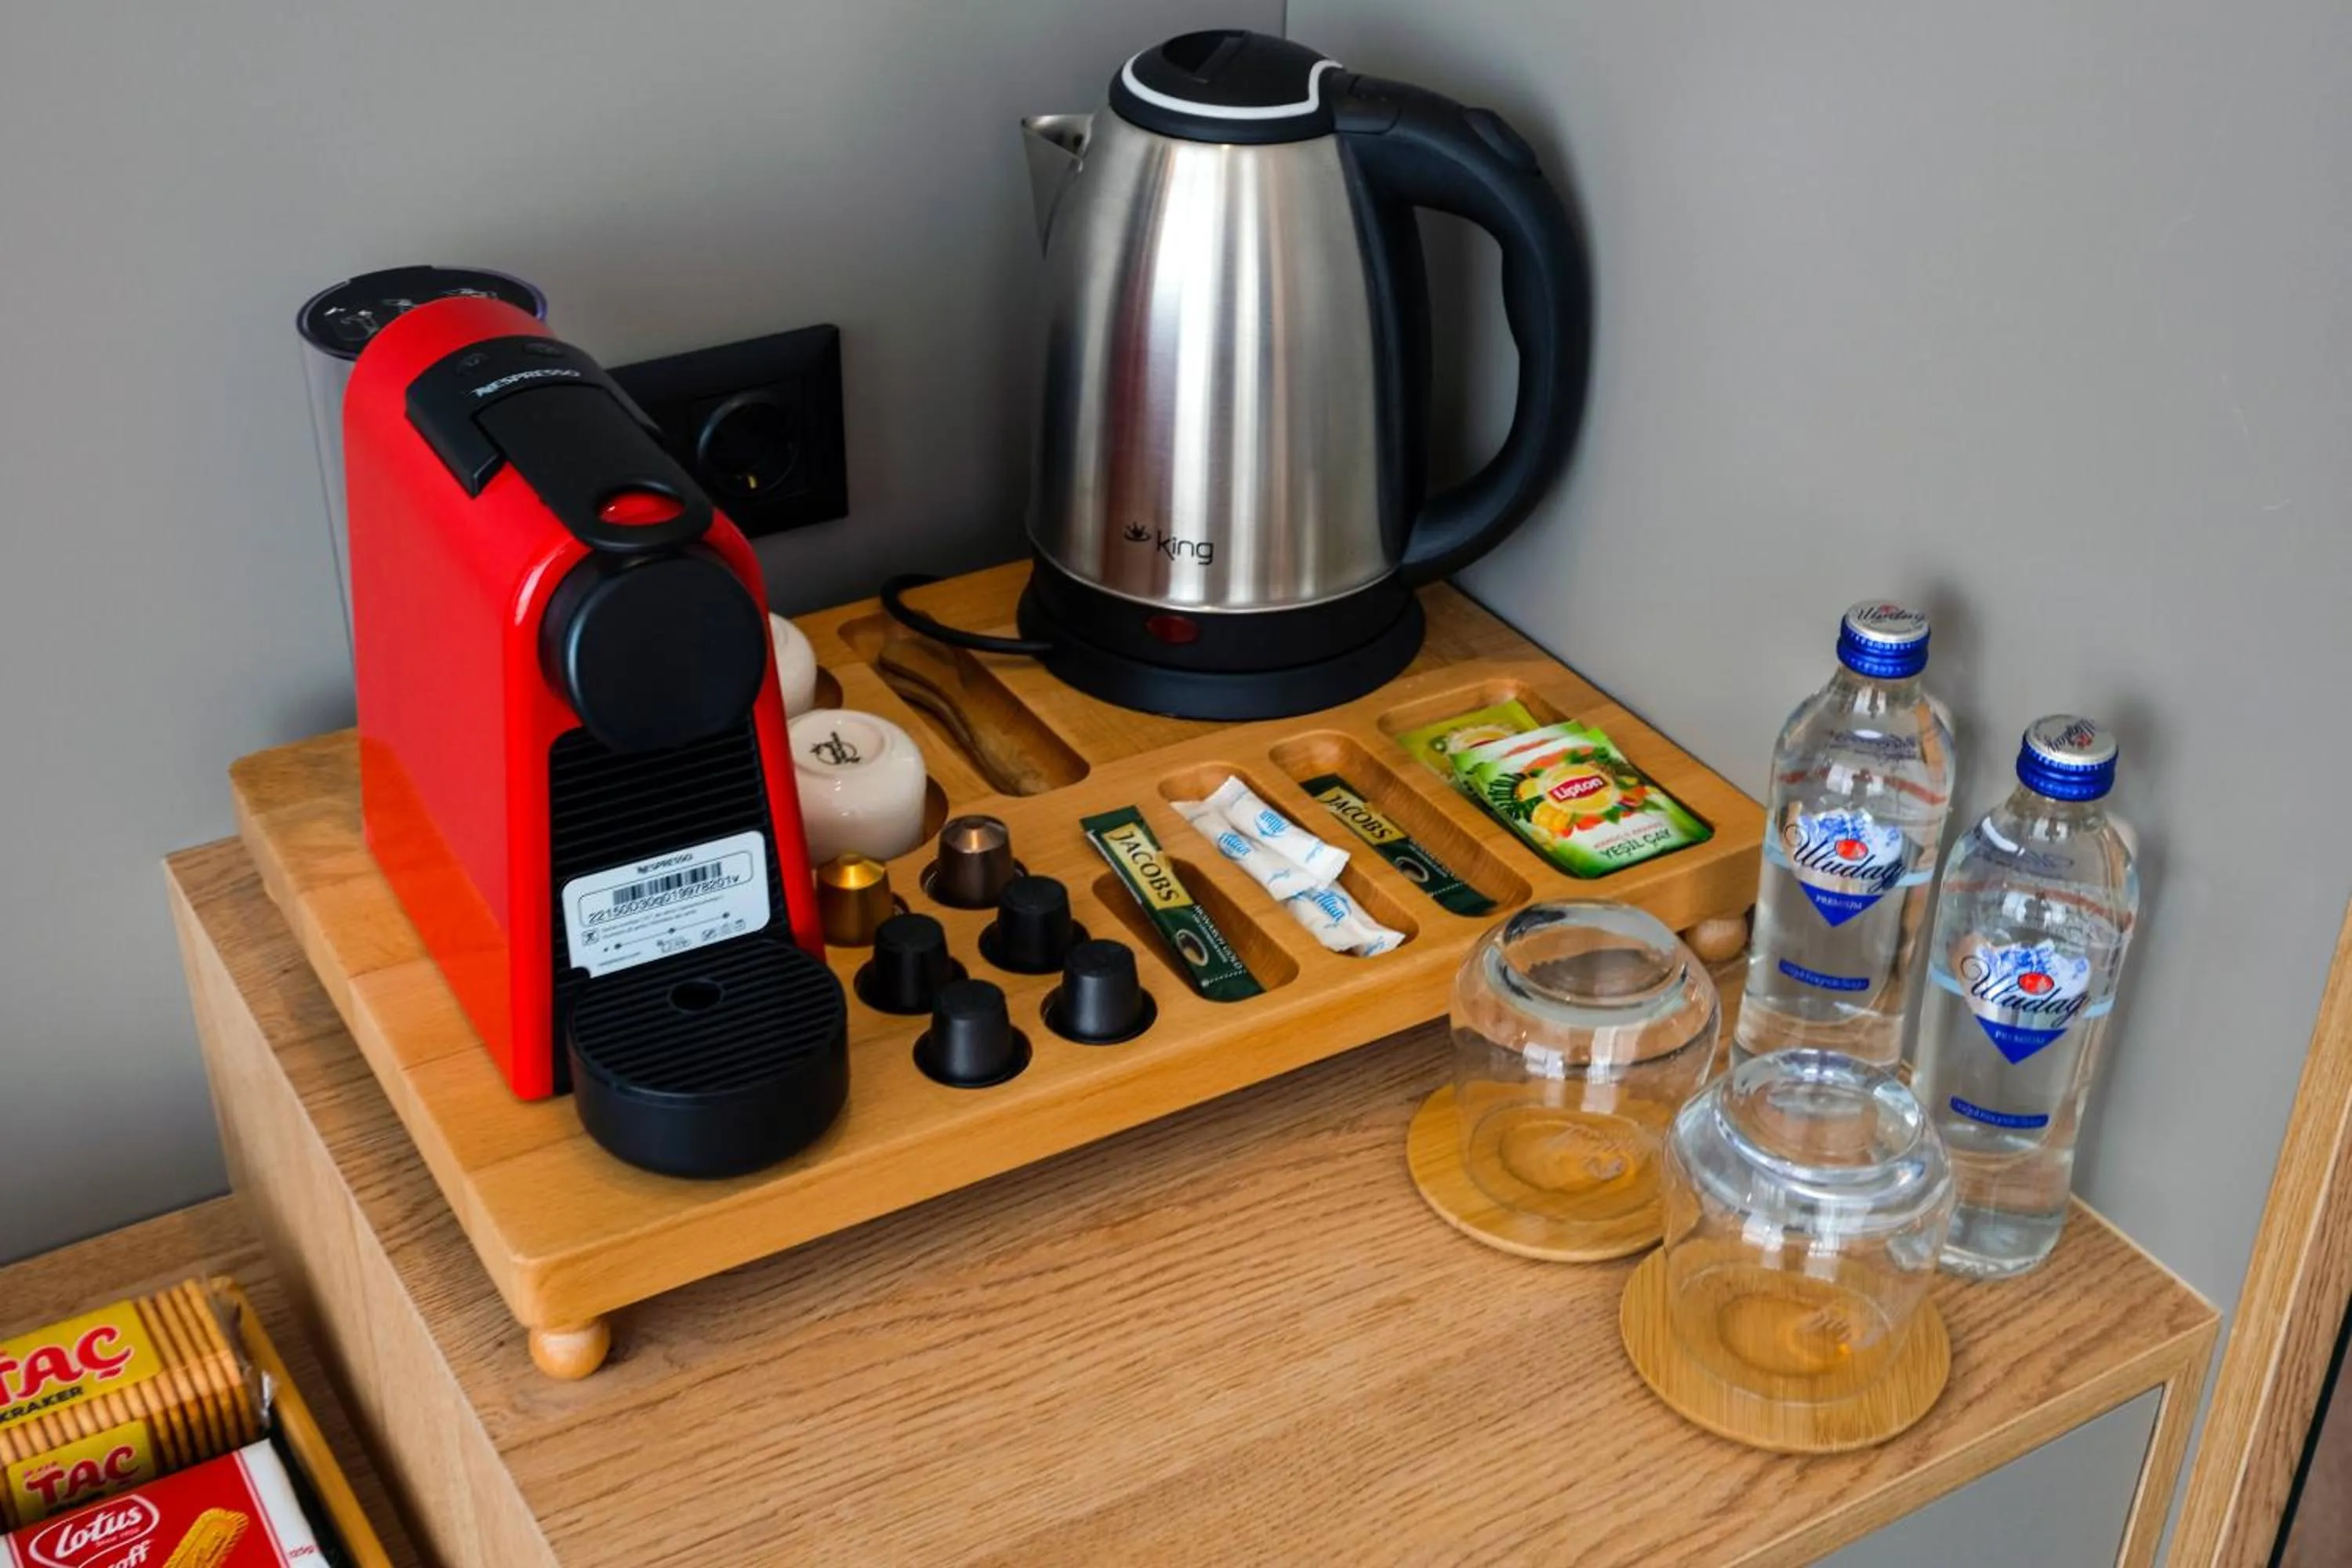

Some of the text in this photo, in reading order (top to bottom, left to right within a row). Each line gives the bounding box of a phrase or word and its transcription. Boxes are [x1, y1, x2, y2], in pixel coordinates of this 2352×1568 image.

[472, 369, 581, 397] NESPRESSO
[1156, 530, 1214, 565] king
[1552, 777, 1604, 800] Lipton
[1322, 793, 1392, 840] JACOBS
[1109, 831, 1179, 902] JACOBS
[24, 1445, 140, 1504] TAÇ
[55, 1506, 143, 1559] Lotus
